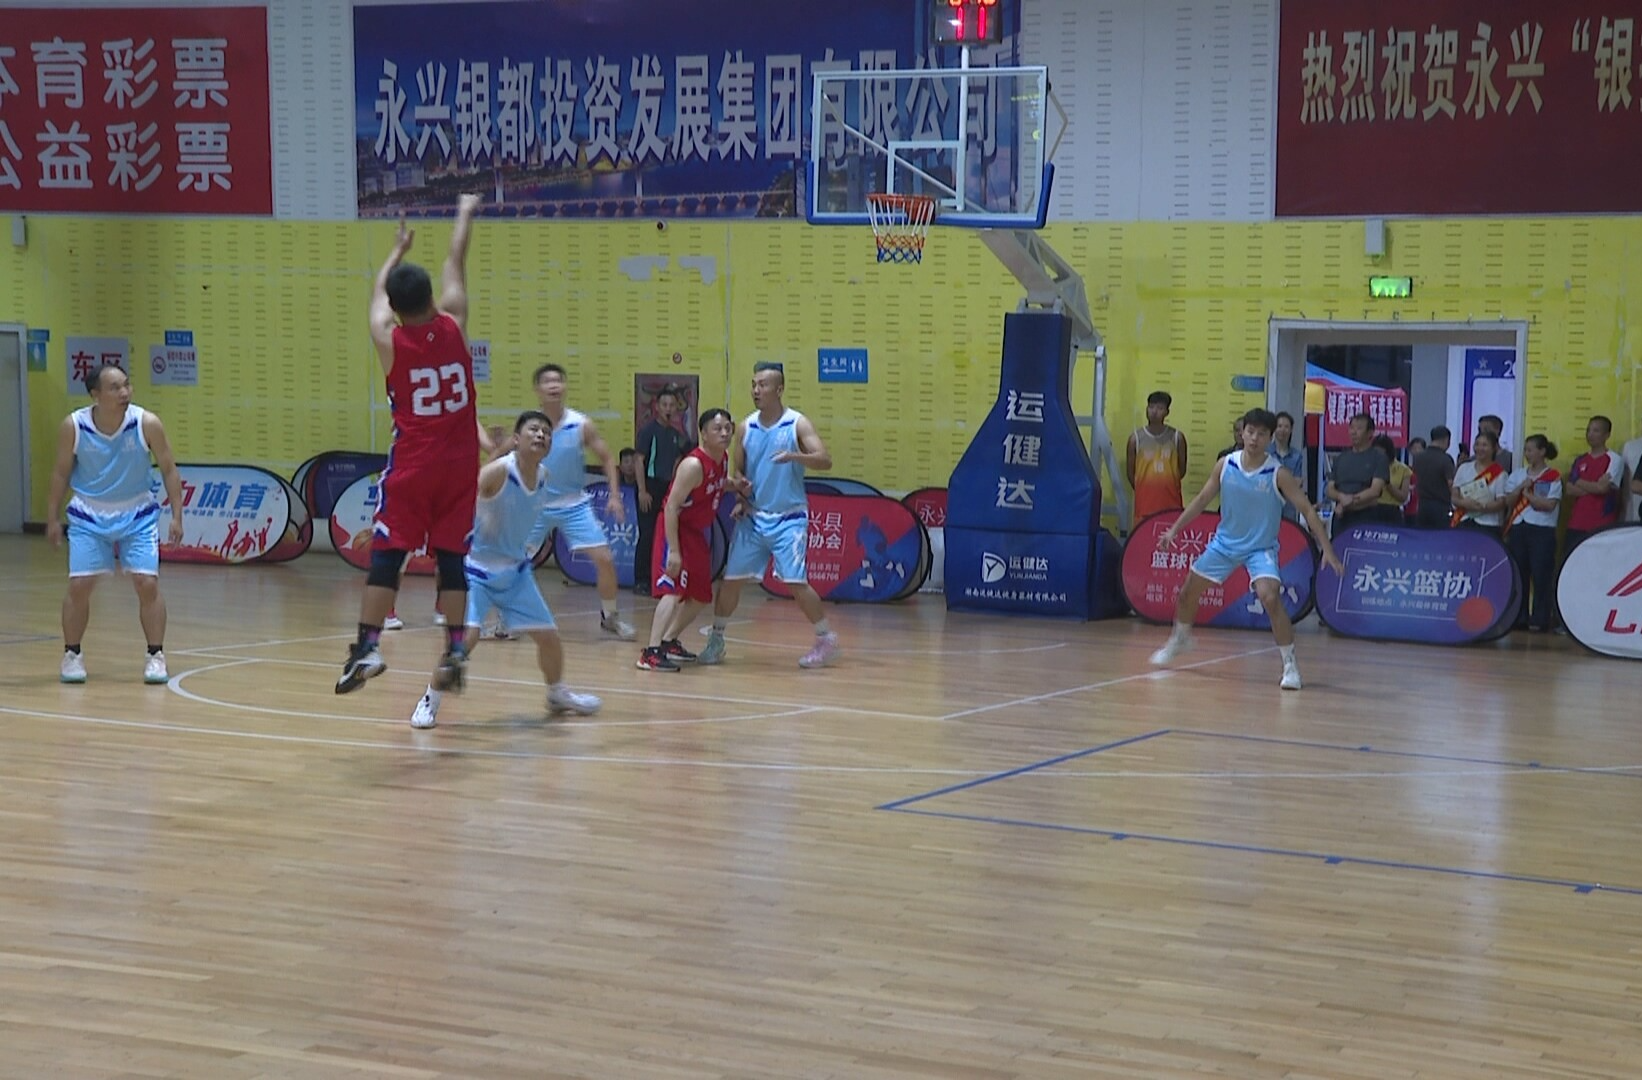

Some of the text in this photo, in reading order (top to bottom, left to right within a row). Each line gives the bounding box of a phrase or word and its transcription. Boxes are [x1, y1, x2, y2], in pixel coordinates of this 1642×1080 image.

[1300, 16, 1642, 124] 热烈祝贺永兴“银
[374, 47, 999, 166] 永兴银都投资发展集团有限公司
[409, 362, 468, 416] 23
[995, 389, 1044, 510] 运健达
[150, 481, 267, 510] 力体育
[808, 532, 842, 550] 协会
[1009, 555, 1048, 570] 运健达
[680, 570, 689, 588] 6
[1353, 564, 1472, 599] 永兴篮协
[1604, 609, 1642, 634] L
